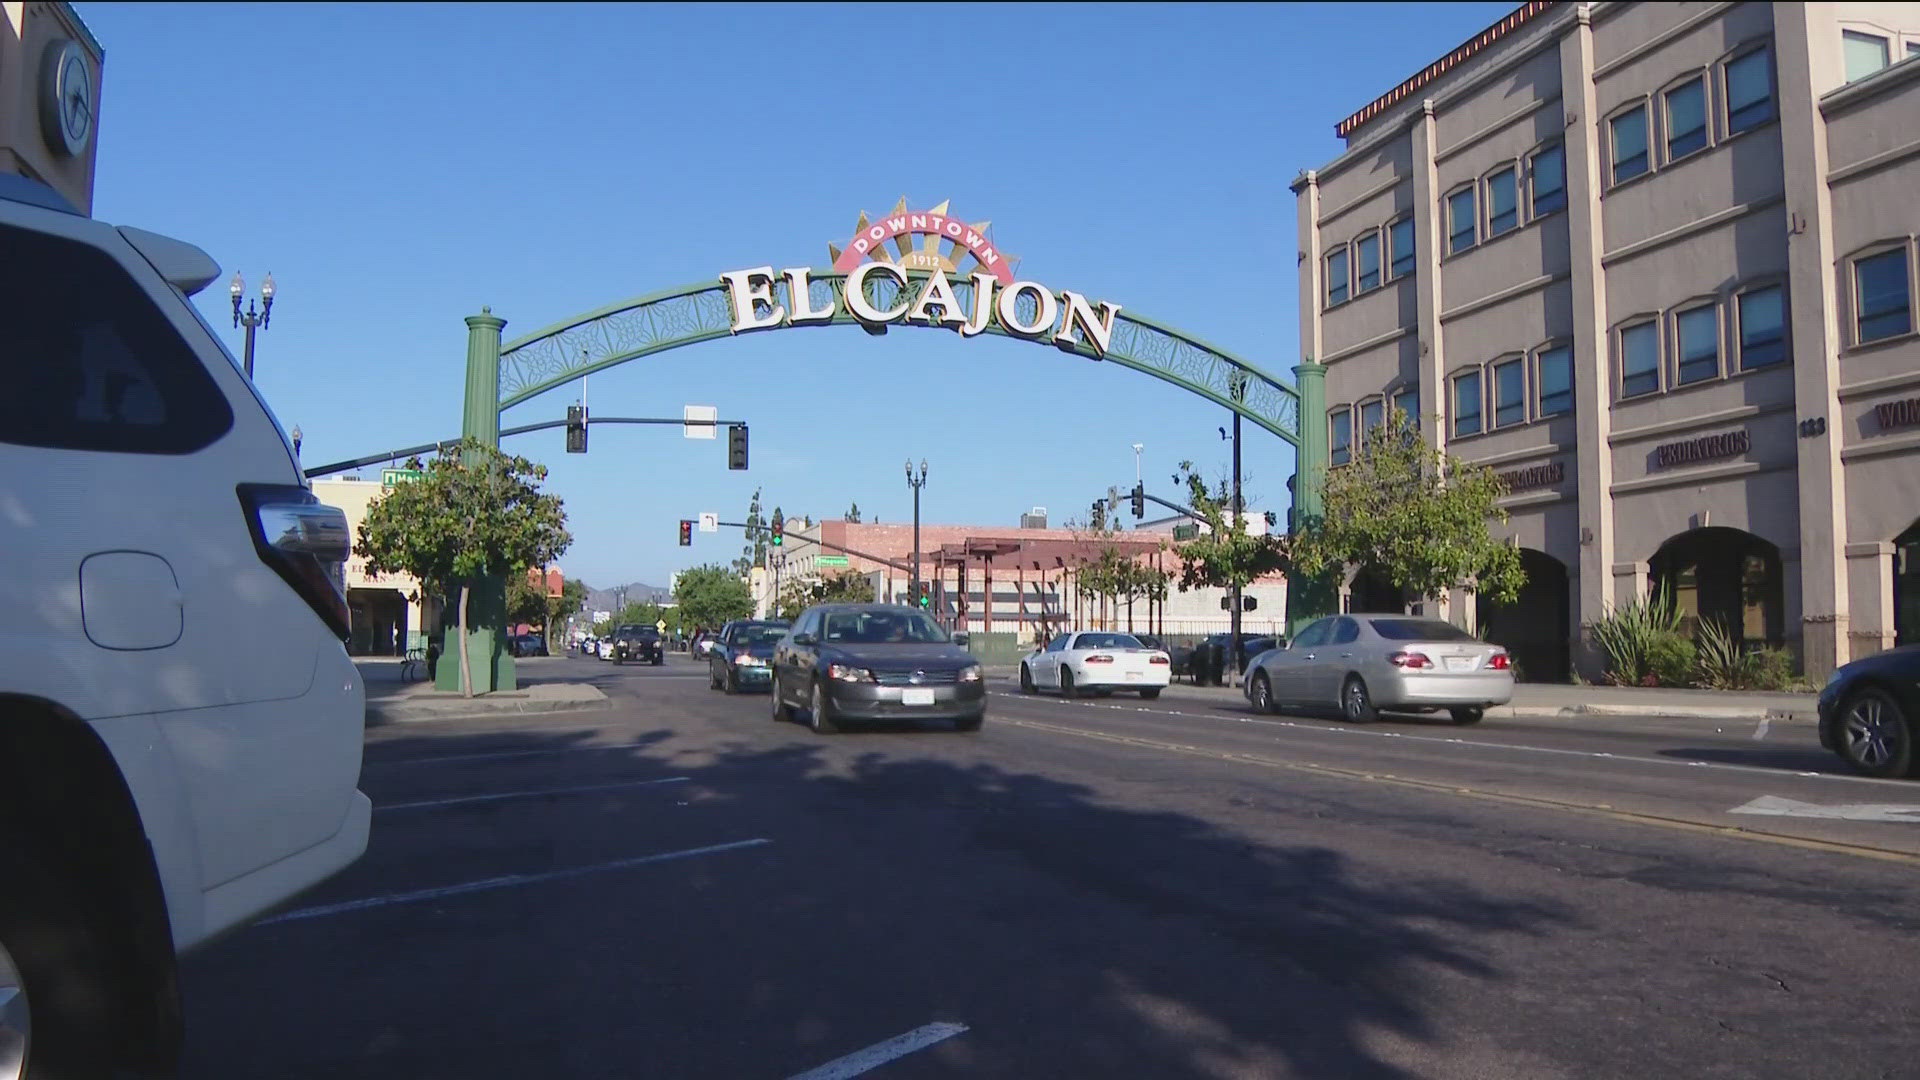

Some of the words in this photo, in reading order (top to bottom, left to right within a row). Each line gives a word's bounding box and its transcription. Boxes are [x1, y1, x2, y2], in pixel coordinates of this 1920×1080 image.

[853, 215, 999, 265] DOWNTOWN
[912, 254, 940, 267] 1912
[719, 265, 836, 336] EL
[843, 261, 1123, 357] CAJON
[1656, 430, 1753, 467] PEDIATRICS
